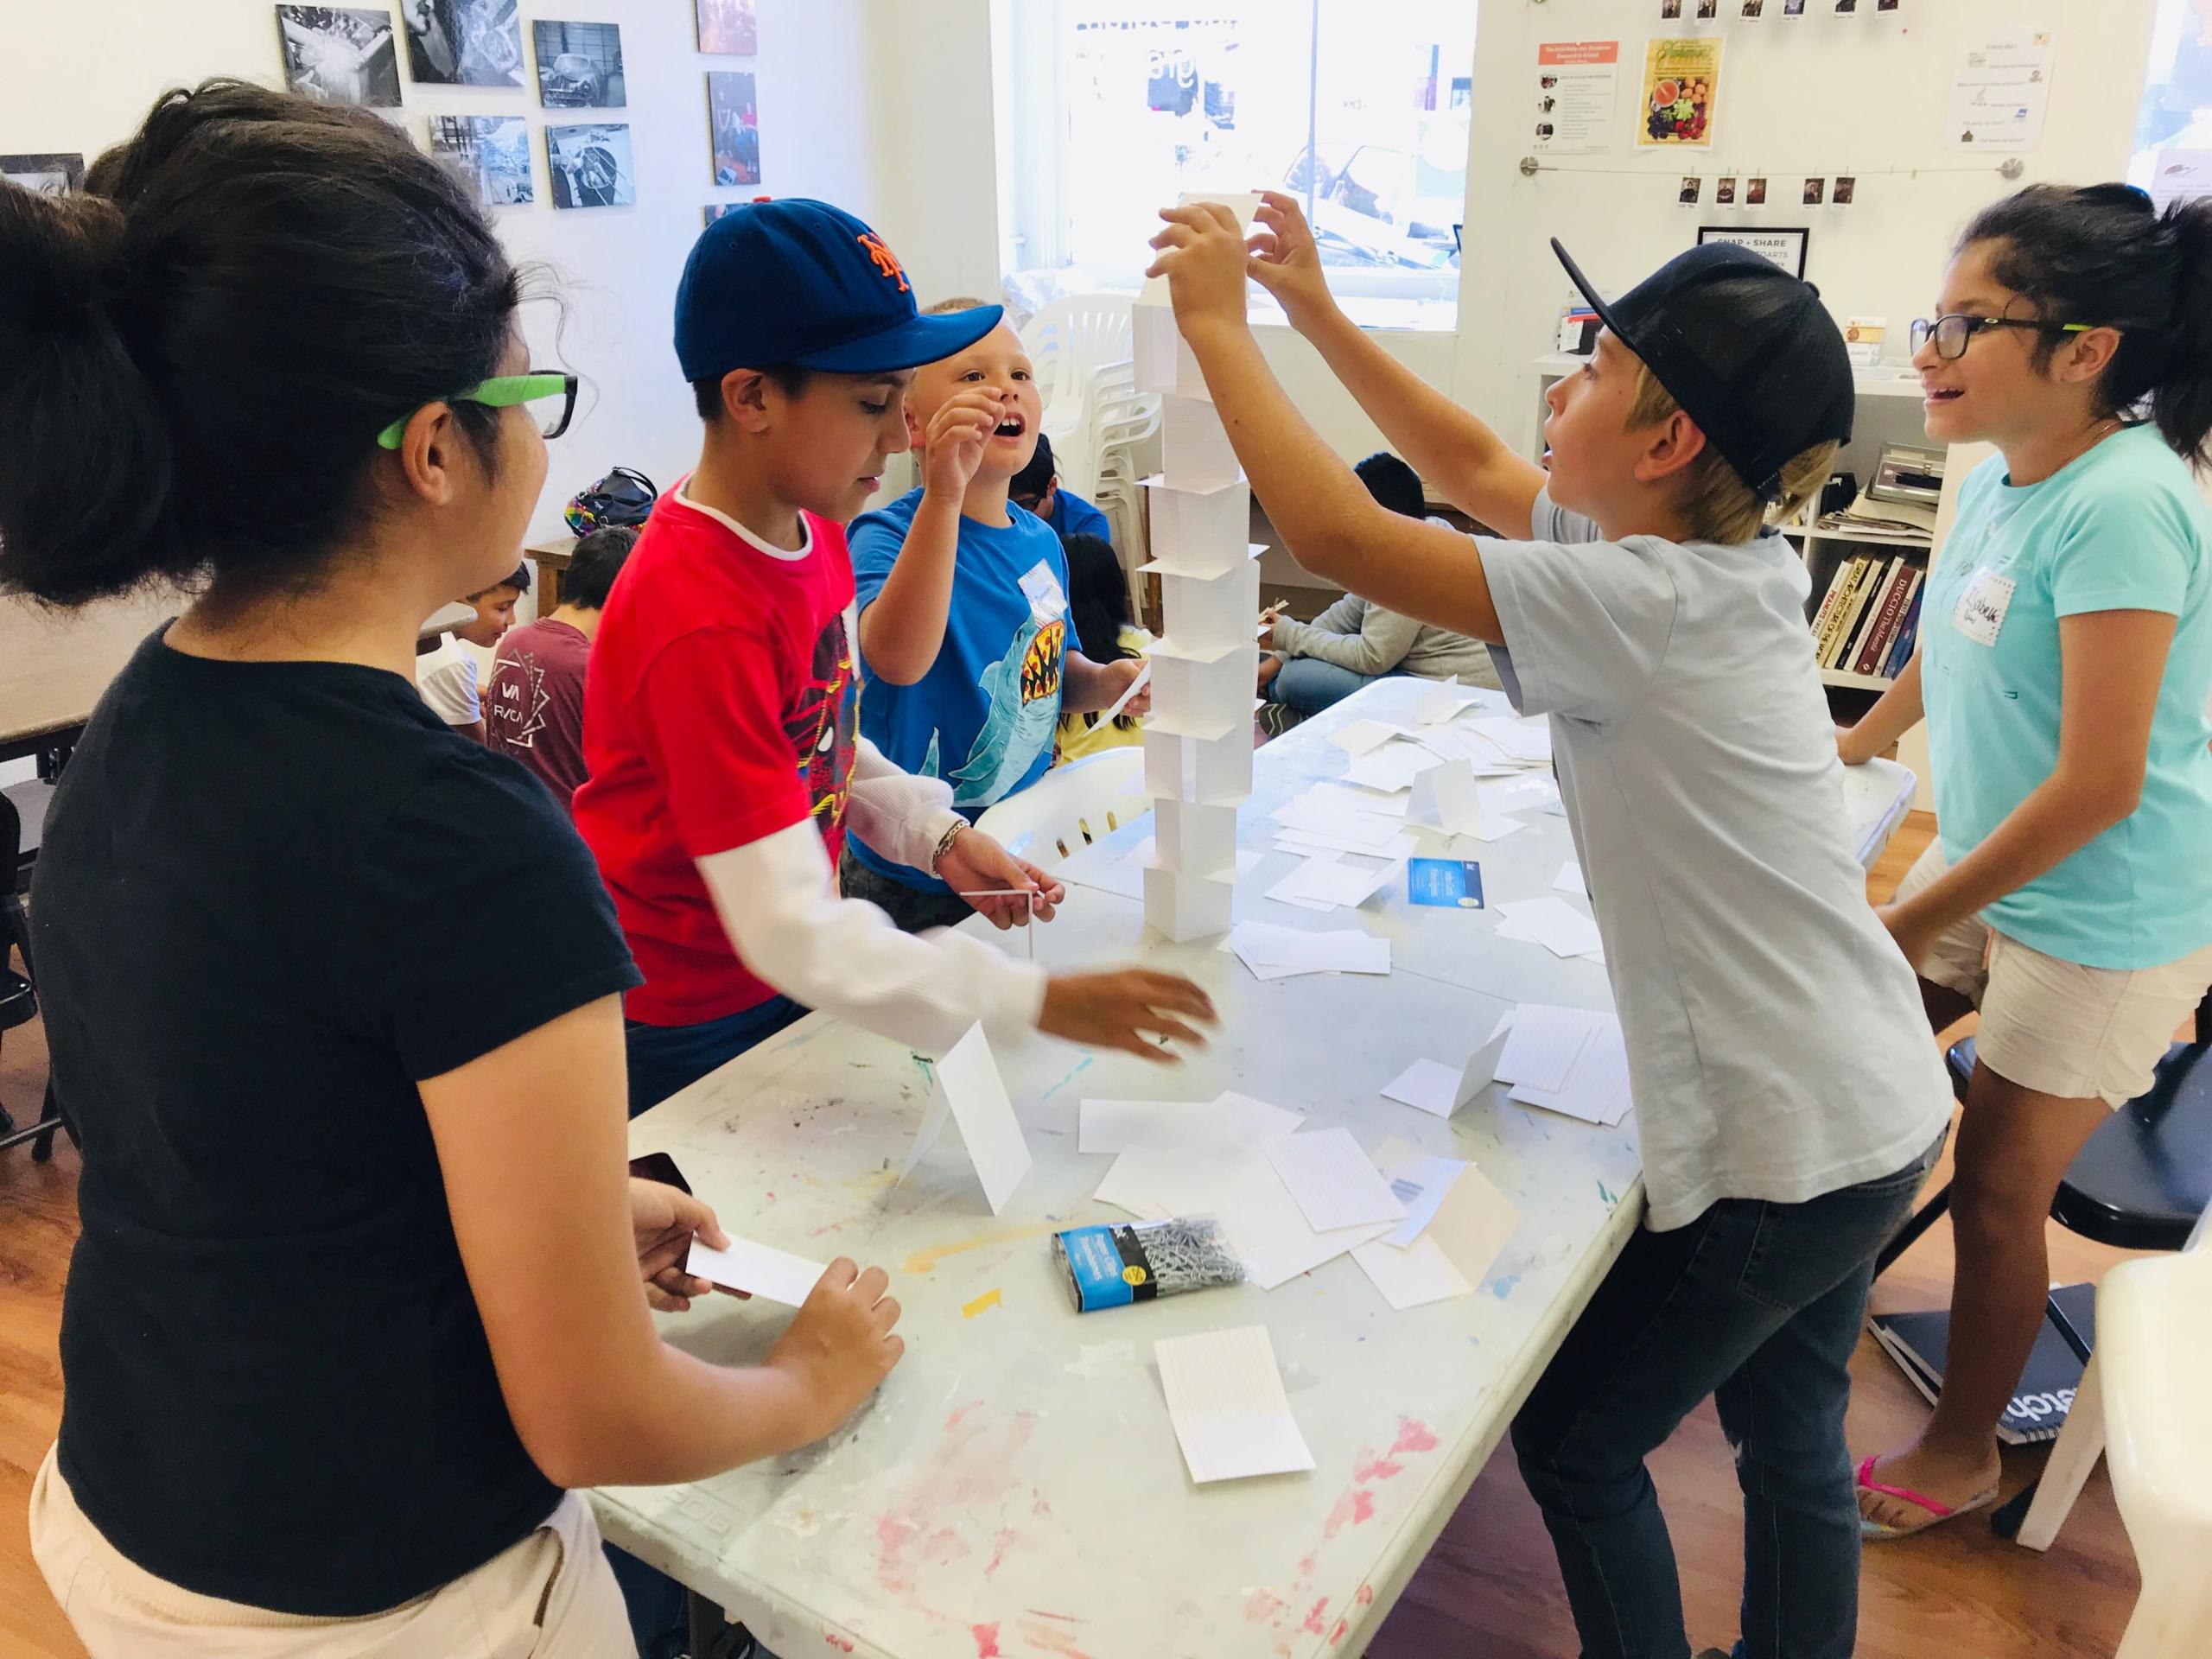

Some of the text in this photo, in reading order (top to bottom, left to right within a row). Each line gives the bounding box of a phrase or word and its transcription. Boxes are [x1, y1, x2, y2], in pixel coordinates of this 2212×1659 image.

[1851, 563, 1864, 582] GREAT
[1819, 589, 1837, 620] PEANUTS
[1885, 579, 1907, 616] DUCCIO
